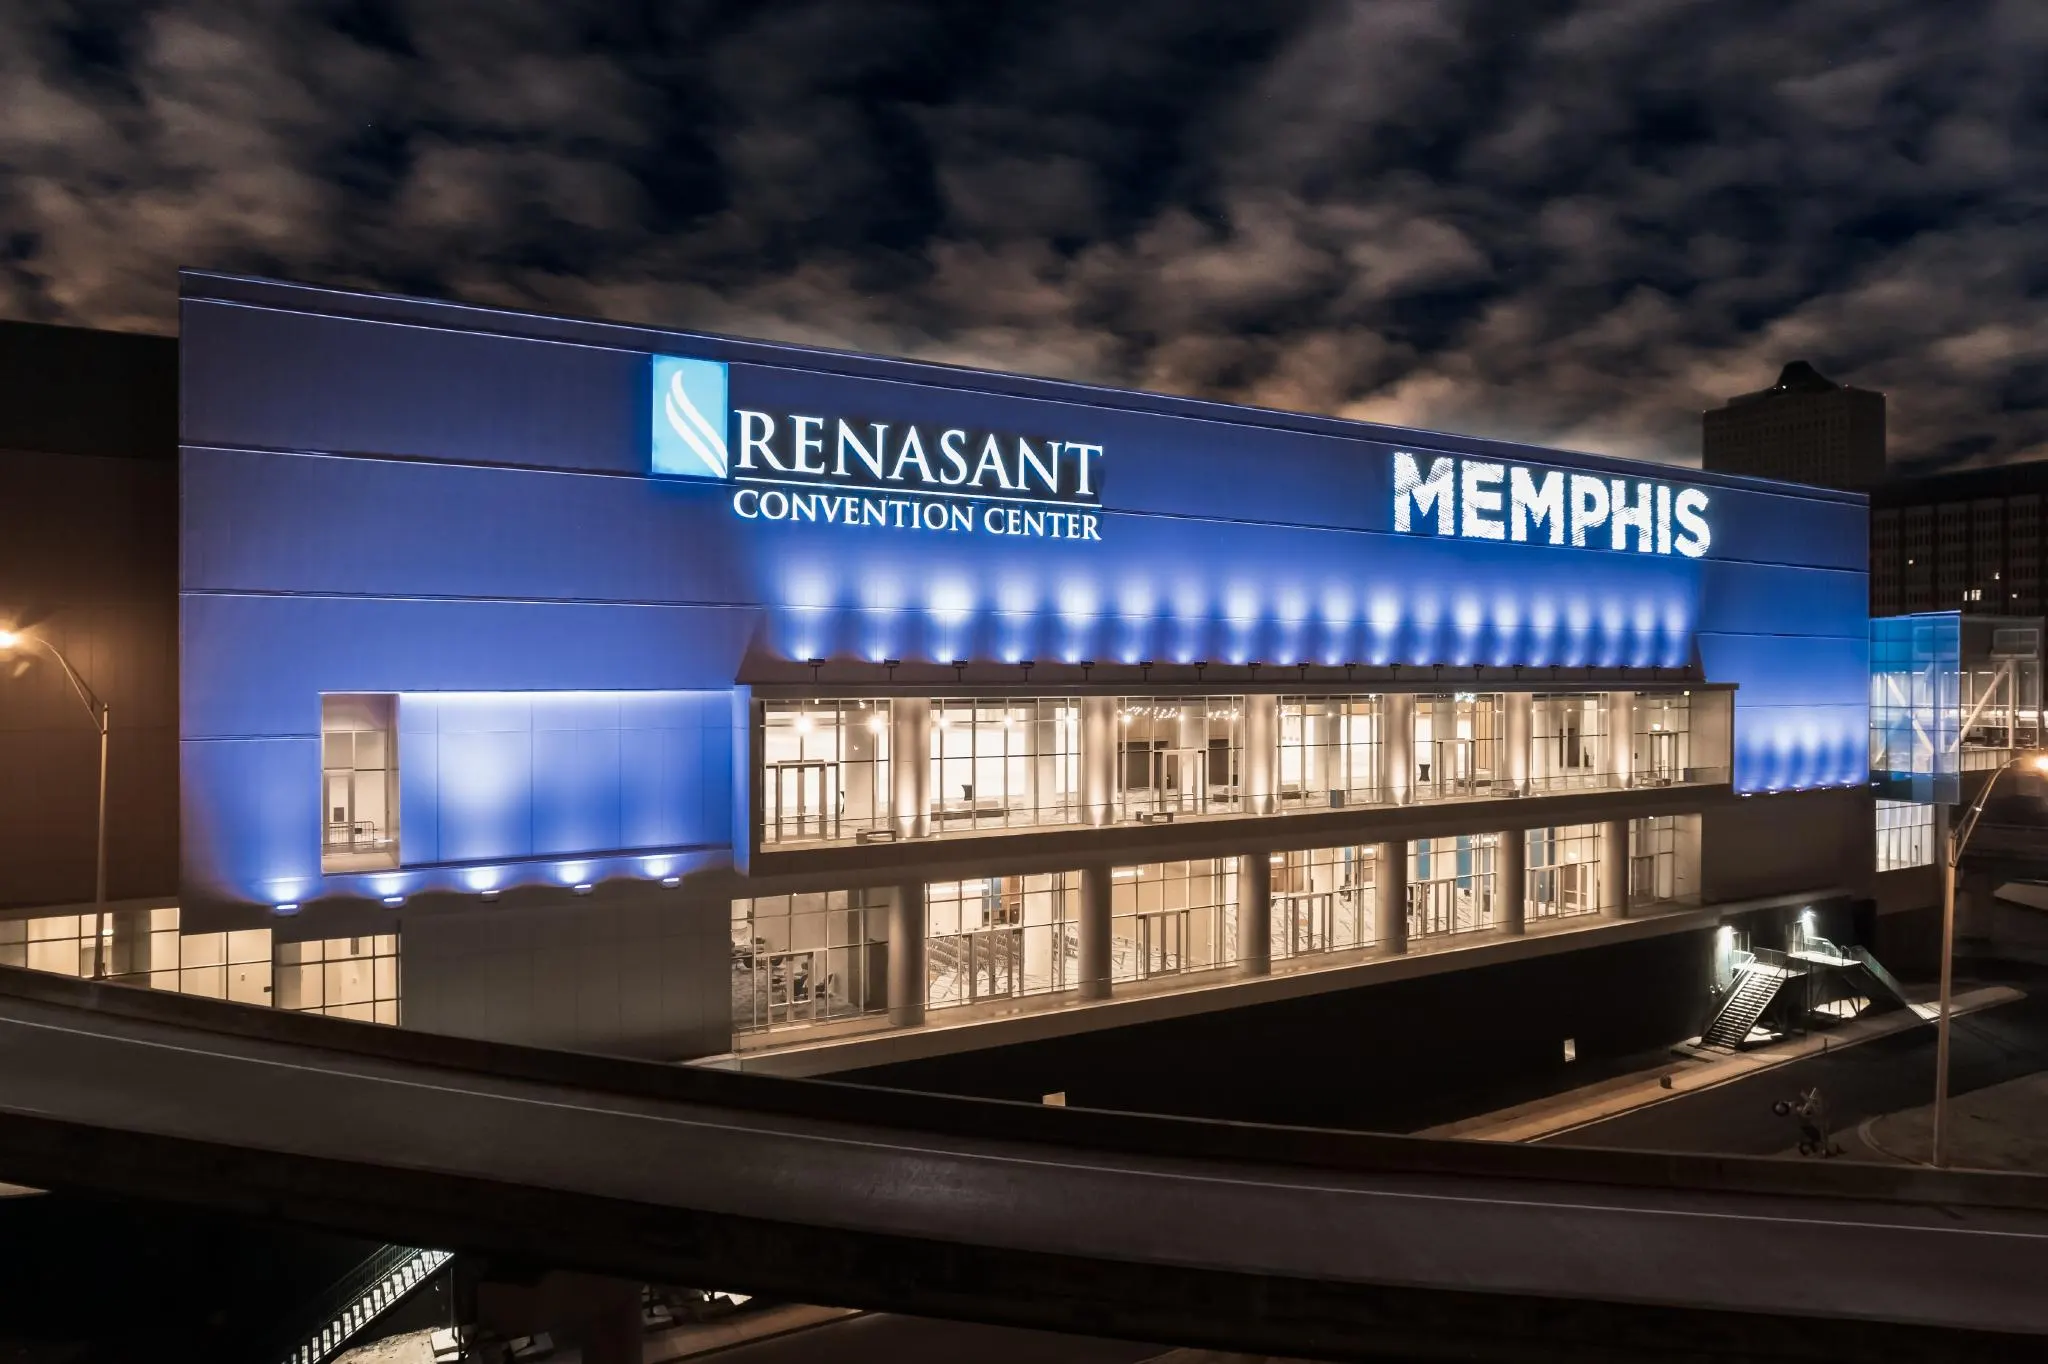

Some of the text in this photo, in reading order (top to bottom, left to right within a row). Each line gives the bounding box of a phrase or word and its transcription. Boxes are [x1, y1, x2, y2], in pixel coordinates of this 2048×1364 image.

[734, 409, 1102, 495] RENASANT
[733, 489, 1101, 540] CONVENTION CENTER
[1394, 452, 1711, 557] MEMPHIS
